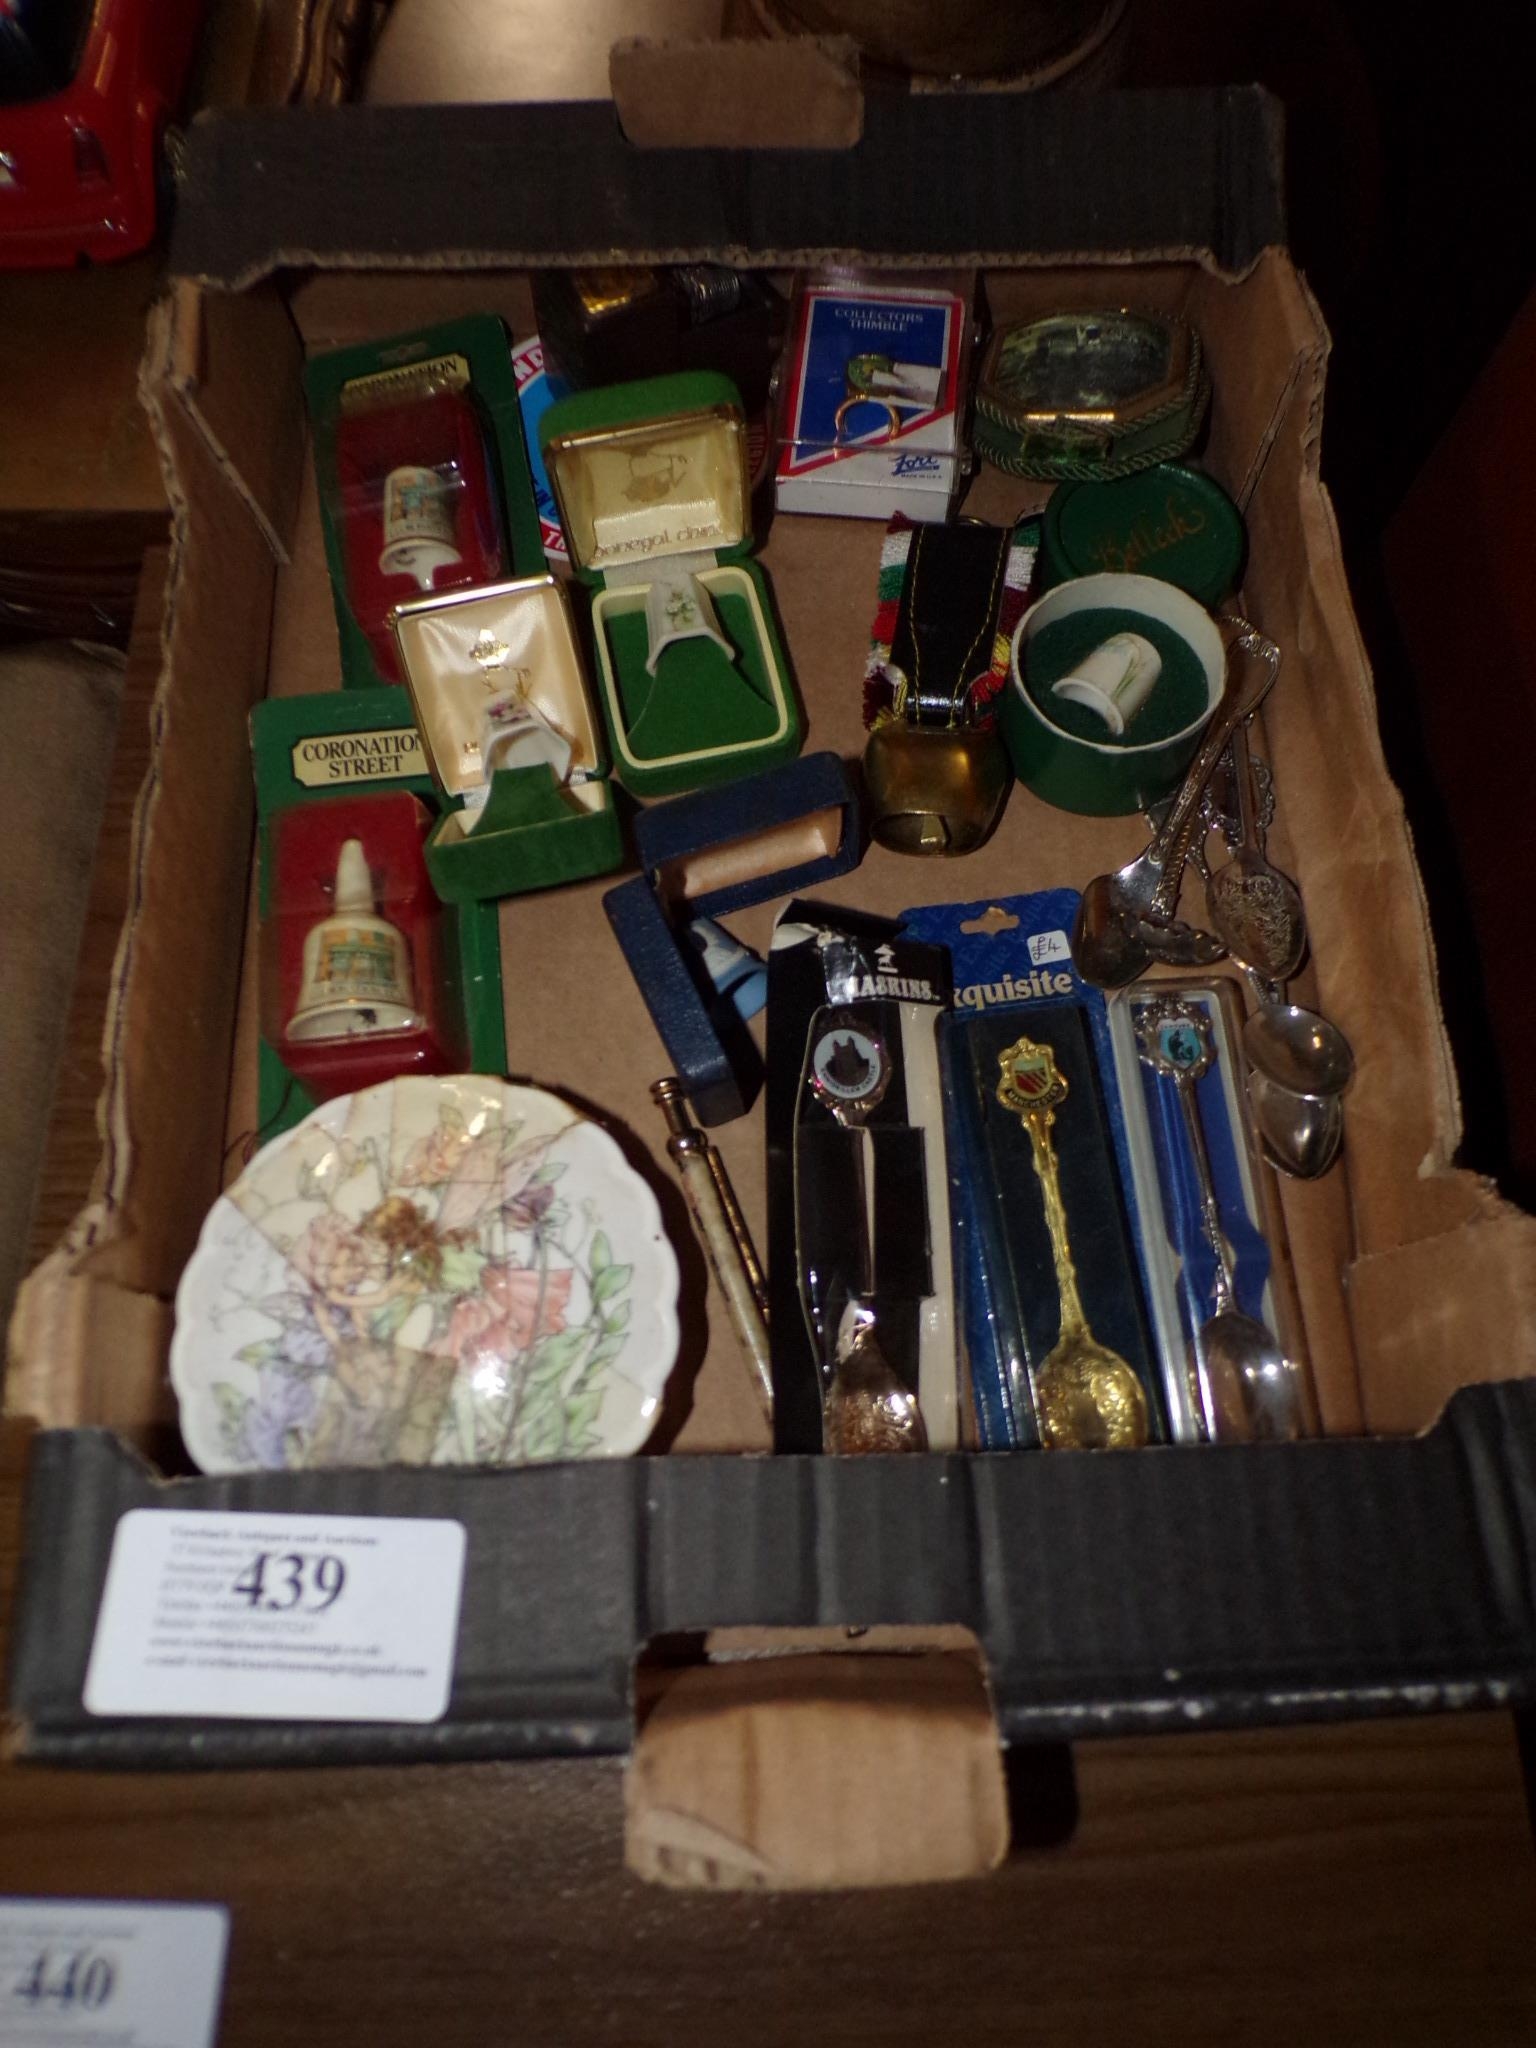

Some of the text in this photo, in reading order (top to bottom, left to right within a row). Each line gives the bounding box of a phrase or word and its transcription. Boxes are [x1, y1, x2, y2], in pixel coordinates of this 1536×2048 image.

[834, 308, 924, 323] COLLECTORS
[850, 318, 908, 332] THIMBLE
[328, 754, 404, 779] STREET
[1032, 935, 1062, 961] £4
[953, 969, 1074, 1011] xquisite
[232, 1551, 347, 1613] 439
[13, 1948, 116, 2012] 440
